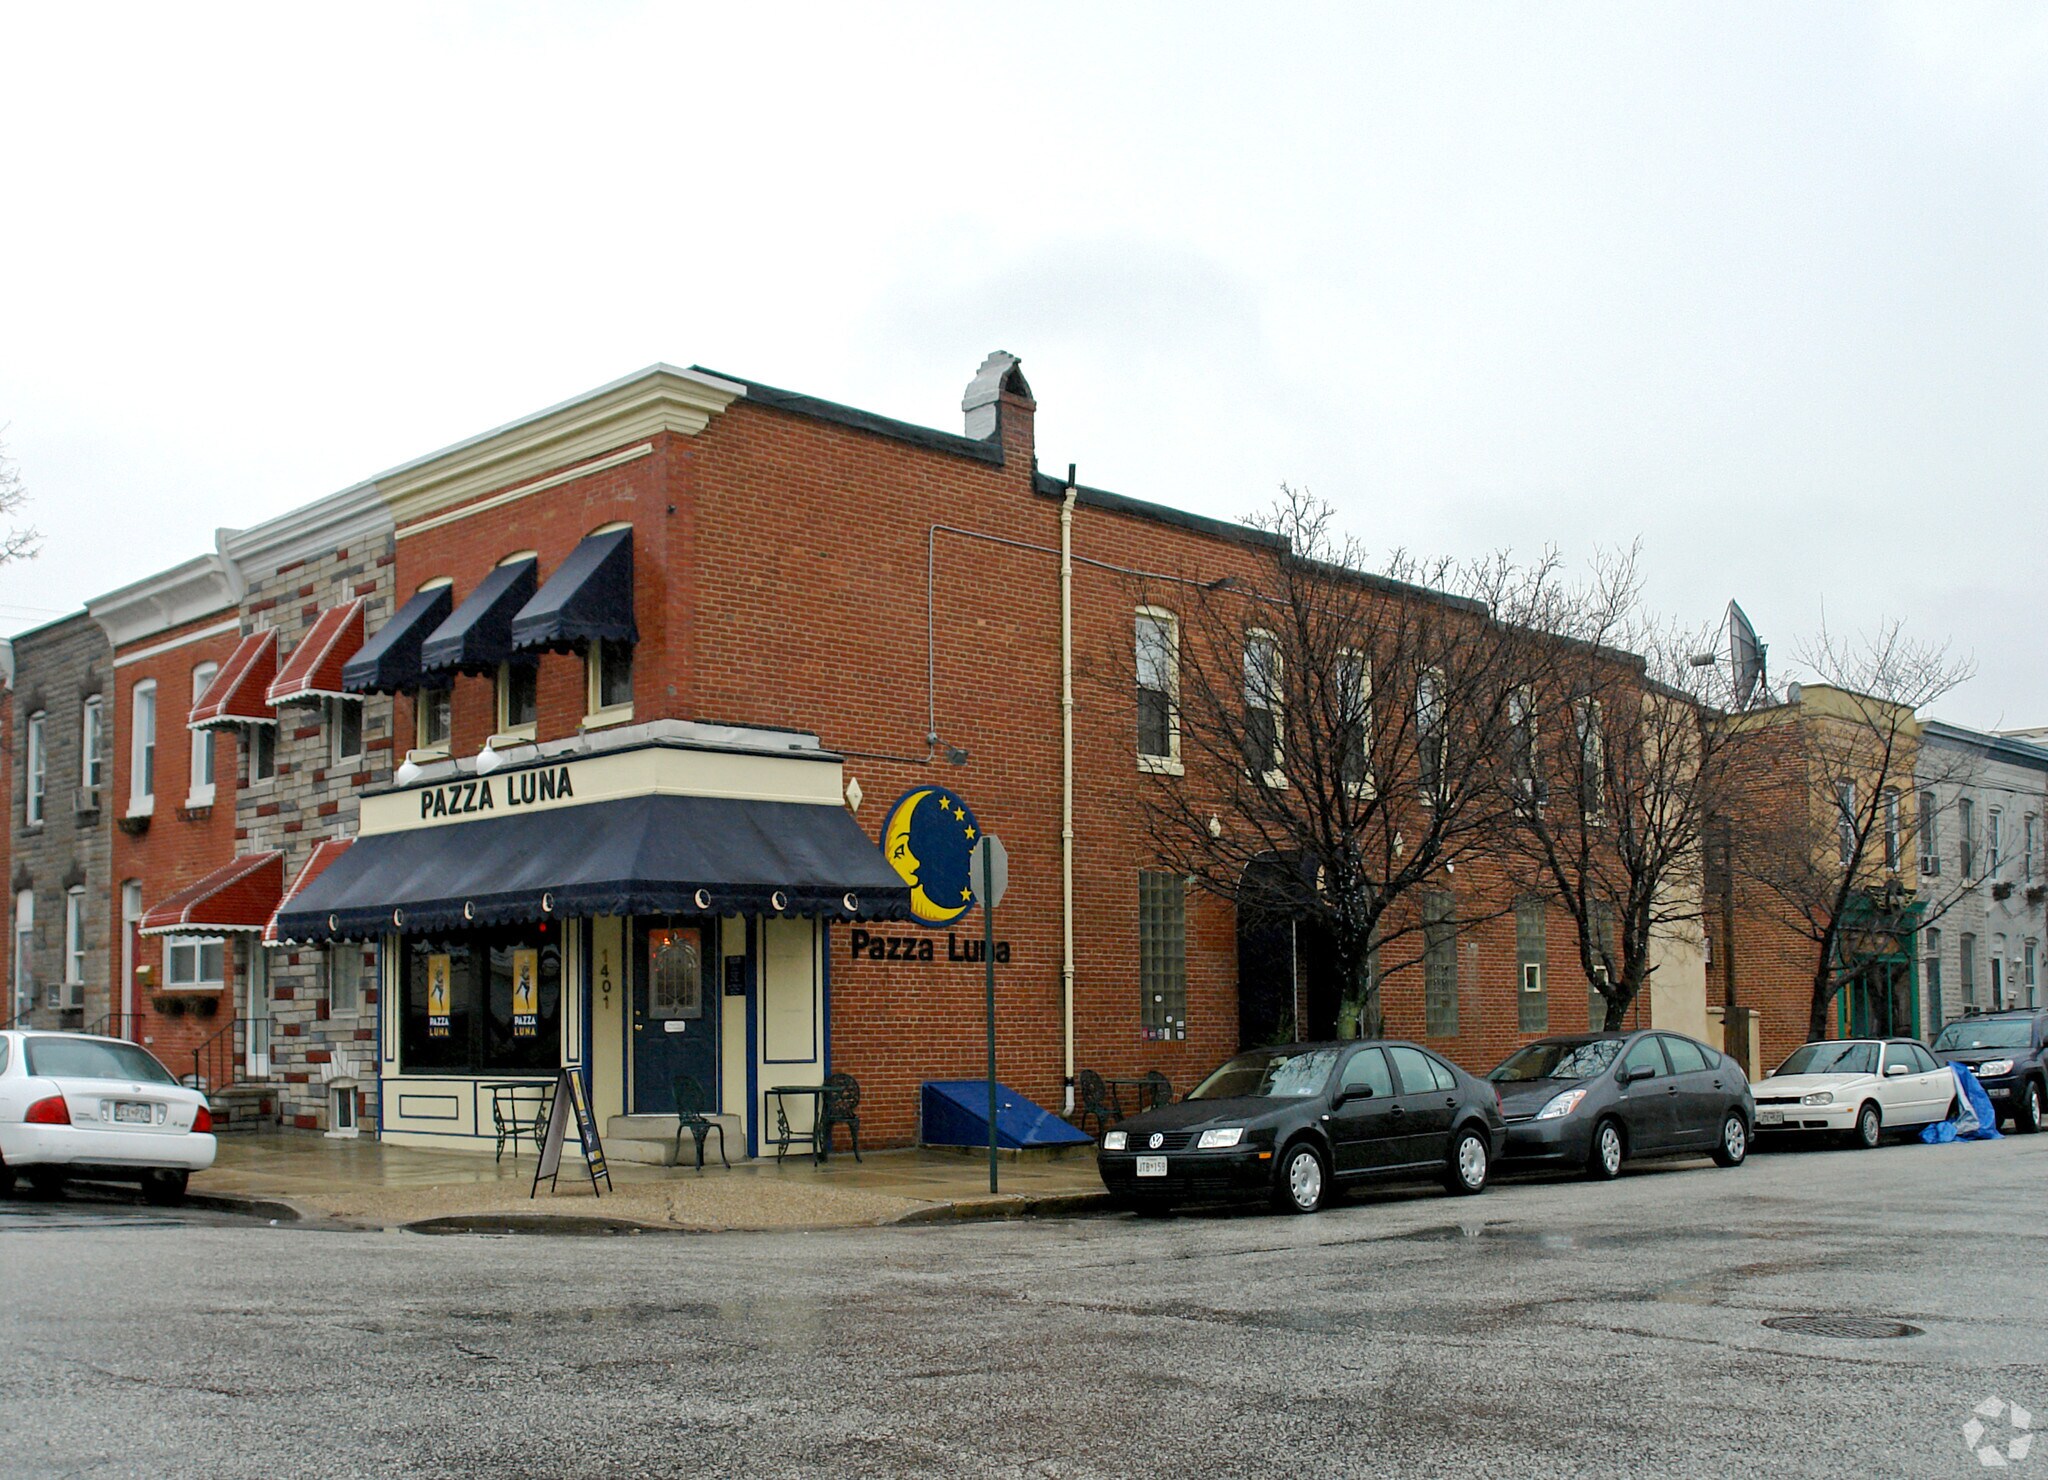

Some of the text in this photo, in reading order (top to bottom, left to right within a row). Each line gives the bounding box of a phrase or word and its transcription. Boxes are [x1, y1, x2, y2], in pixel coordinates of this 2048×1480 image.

[421, 766, 574, 819] PAZZA LUNA
[851, 928, 934, 962] Pazza
[600, 948, 612, 1010] 1401
[429, 1016, 449, 1026] PAZZA
[514, 1015, 536, 1026] PAZZA
[429, 1027, 449, 1037] LUNA
[514, 1026, 536, 1037] LUNA
